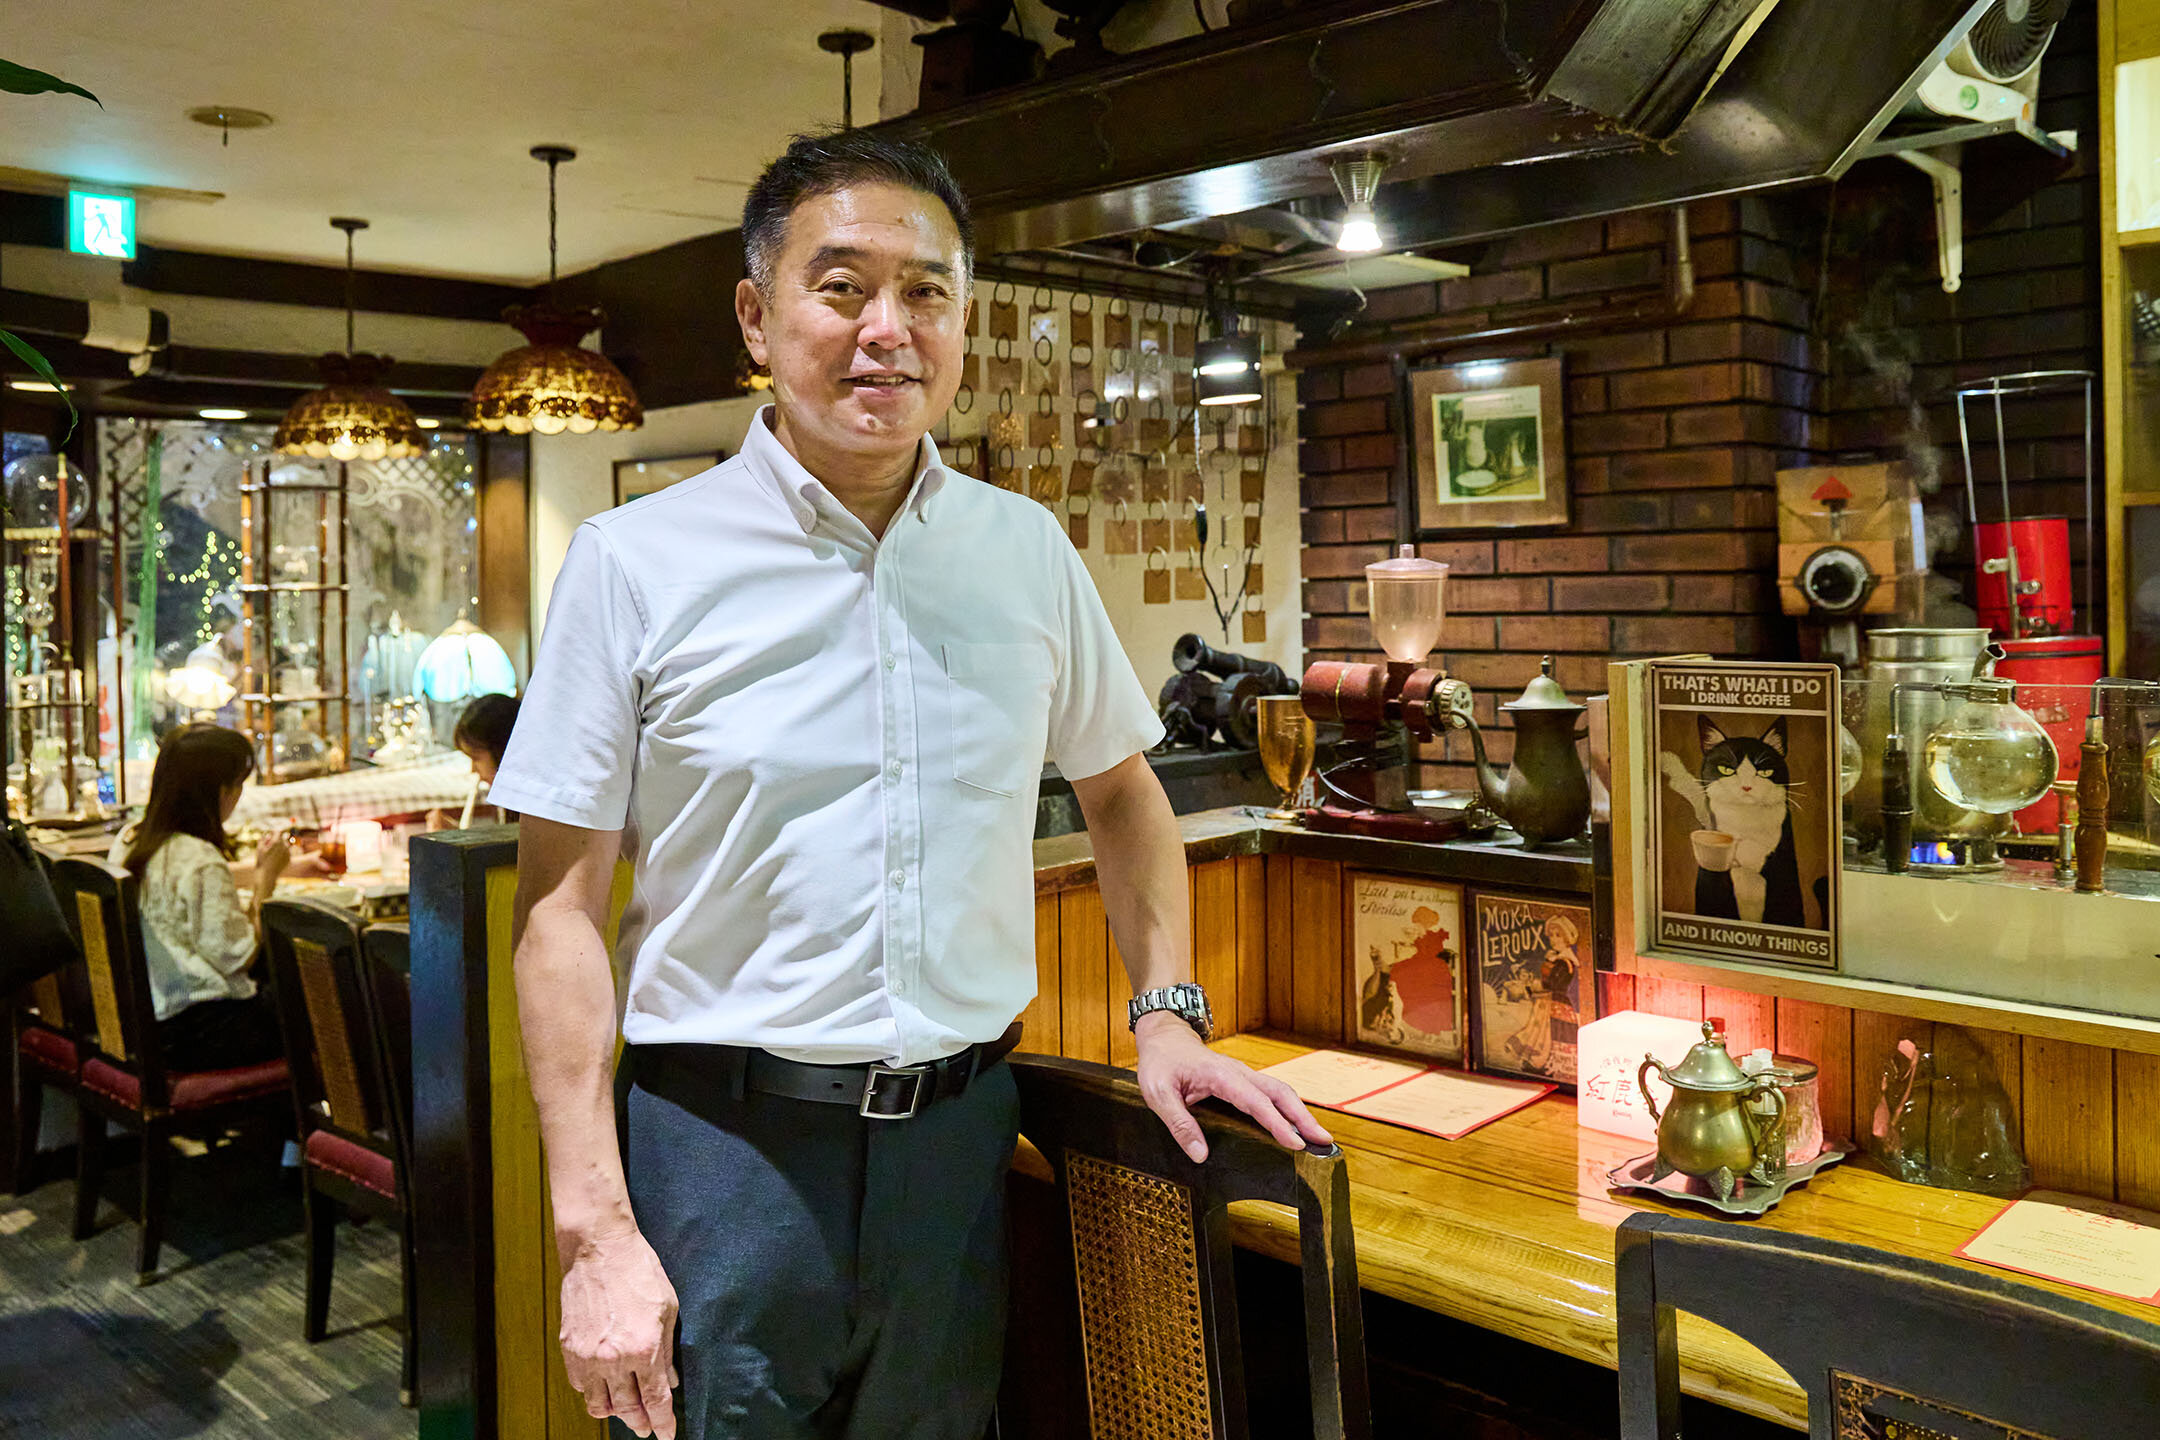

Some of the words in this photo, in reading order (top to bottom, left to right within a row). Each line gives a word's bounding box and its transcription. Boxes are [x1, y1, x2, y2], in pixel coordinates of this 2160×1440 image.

[1663, 675, 1720, 692] THAT'S
[1724, 677, 1778, 693] WHAT
[1783, 678, 1789, 693] I
[1793, 679, 1821, 695] DO
[1690, 691, 1695, 703] I
[1698, 692, 1740, 705] DRINK
[1743, 693, 1791, 706] COFFEE
[1485, 904, 1534, 932] MOKA
[1482, 924, 1546, 967] LEROUX
[1664, 922, 1699, 939] AND
[1702, 927, 1708, 940] I
[1710, 929, 1763, 948] KNOW
[1765, 935, 1829, 956] THINGS
